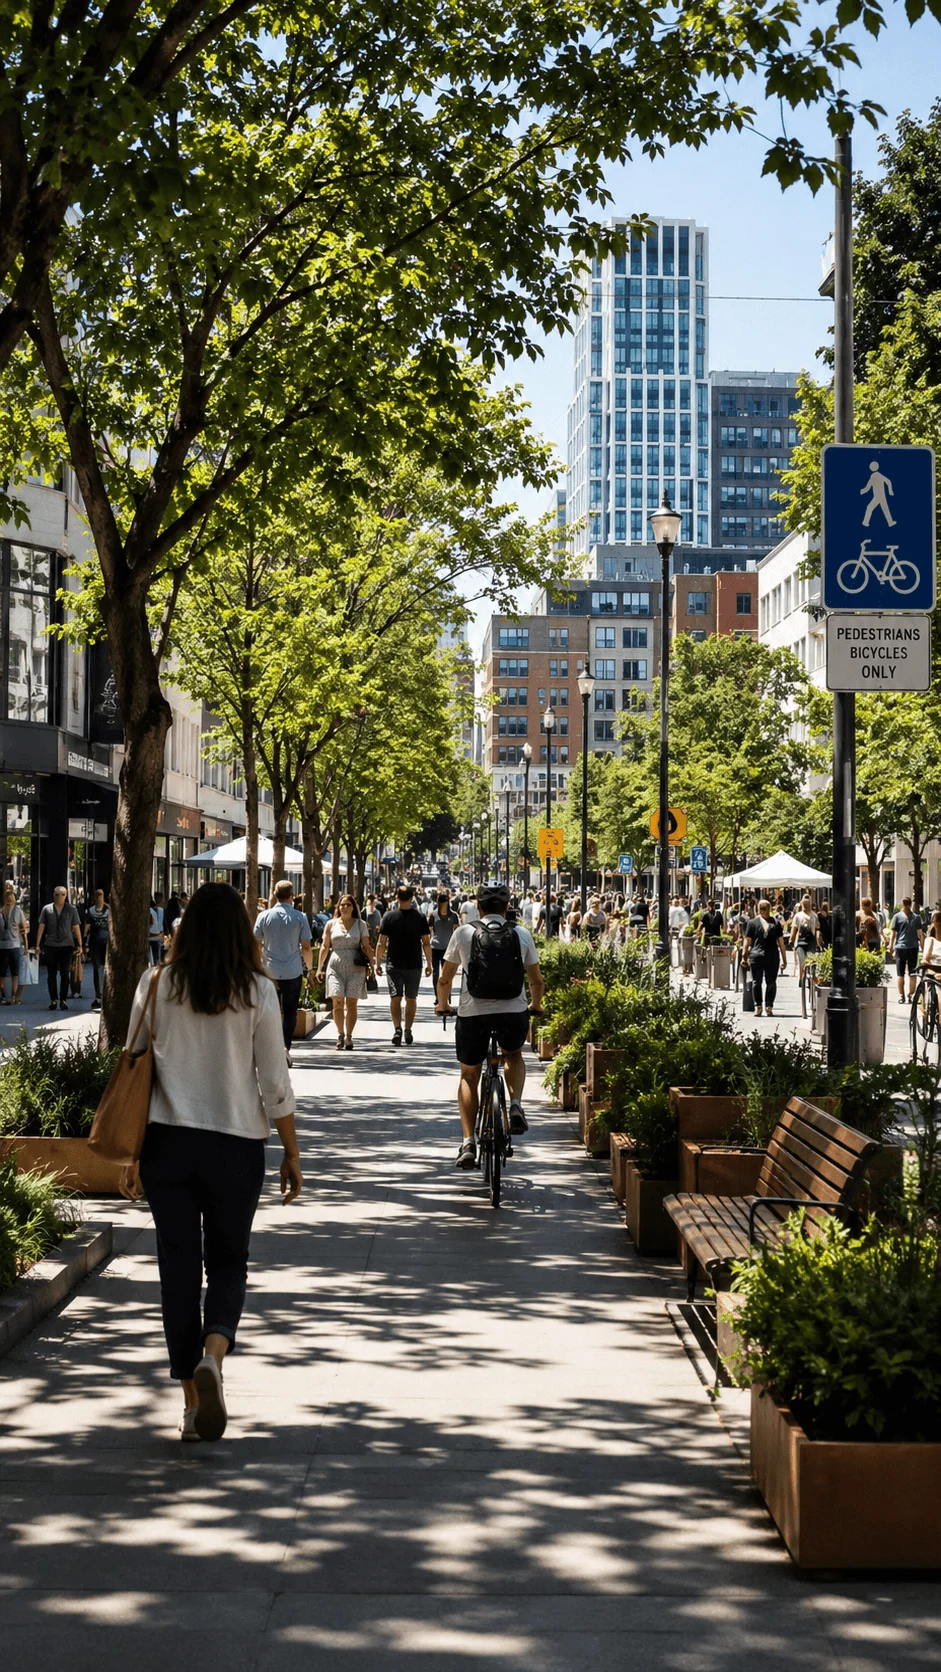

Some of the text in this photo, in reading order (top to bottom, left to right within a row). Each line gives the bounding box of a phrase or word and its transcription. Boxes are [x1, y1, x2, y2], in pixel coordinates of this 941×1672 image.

[837, 628, 920, 640] PEDESTRIANS
[850, 647, 908, 659] BICYCLES
[861, 665, 897, 679] ONLY
